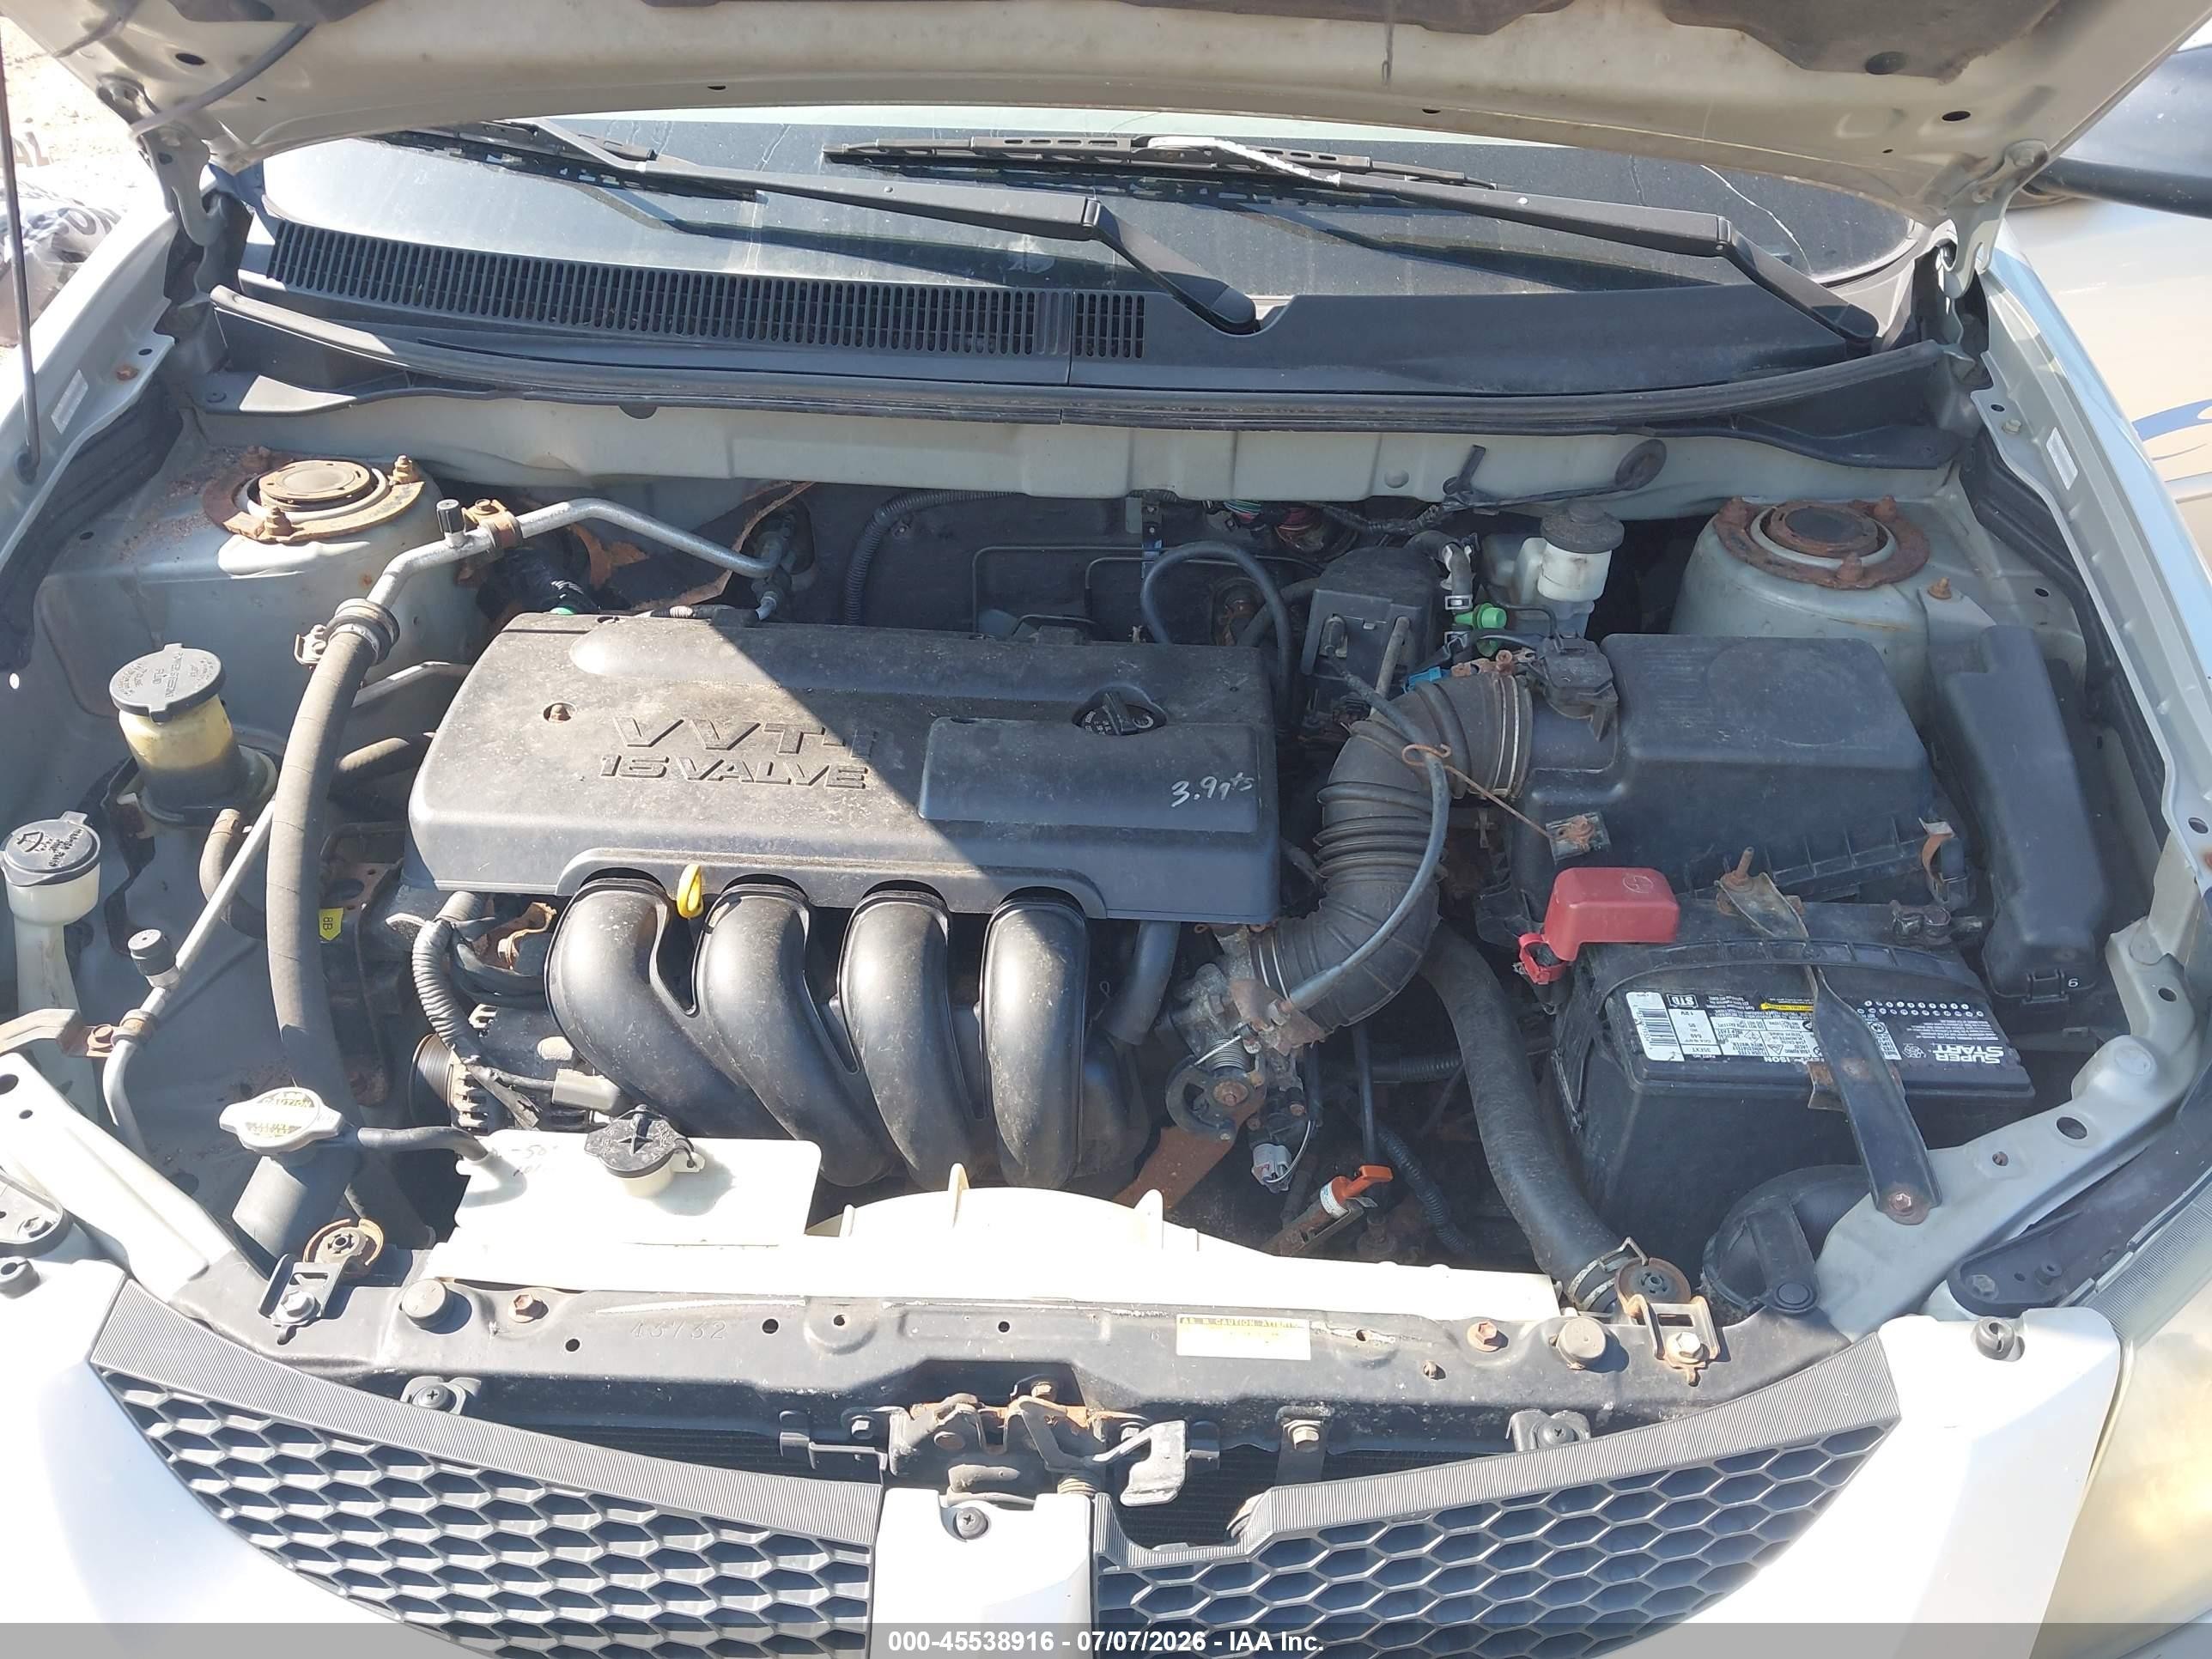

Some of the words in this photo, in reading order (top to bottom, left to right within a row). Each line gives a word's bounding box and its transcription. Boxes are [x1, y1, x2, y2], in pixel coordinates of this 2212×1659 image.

[1671, 996, 1695, 1006] STD
[1932, 1044, 2004, 1057] START
[1936, 1053, 2001, 1064] SUPER
[1215, 1318, 1255, 1327] CAUTION
